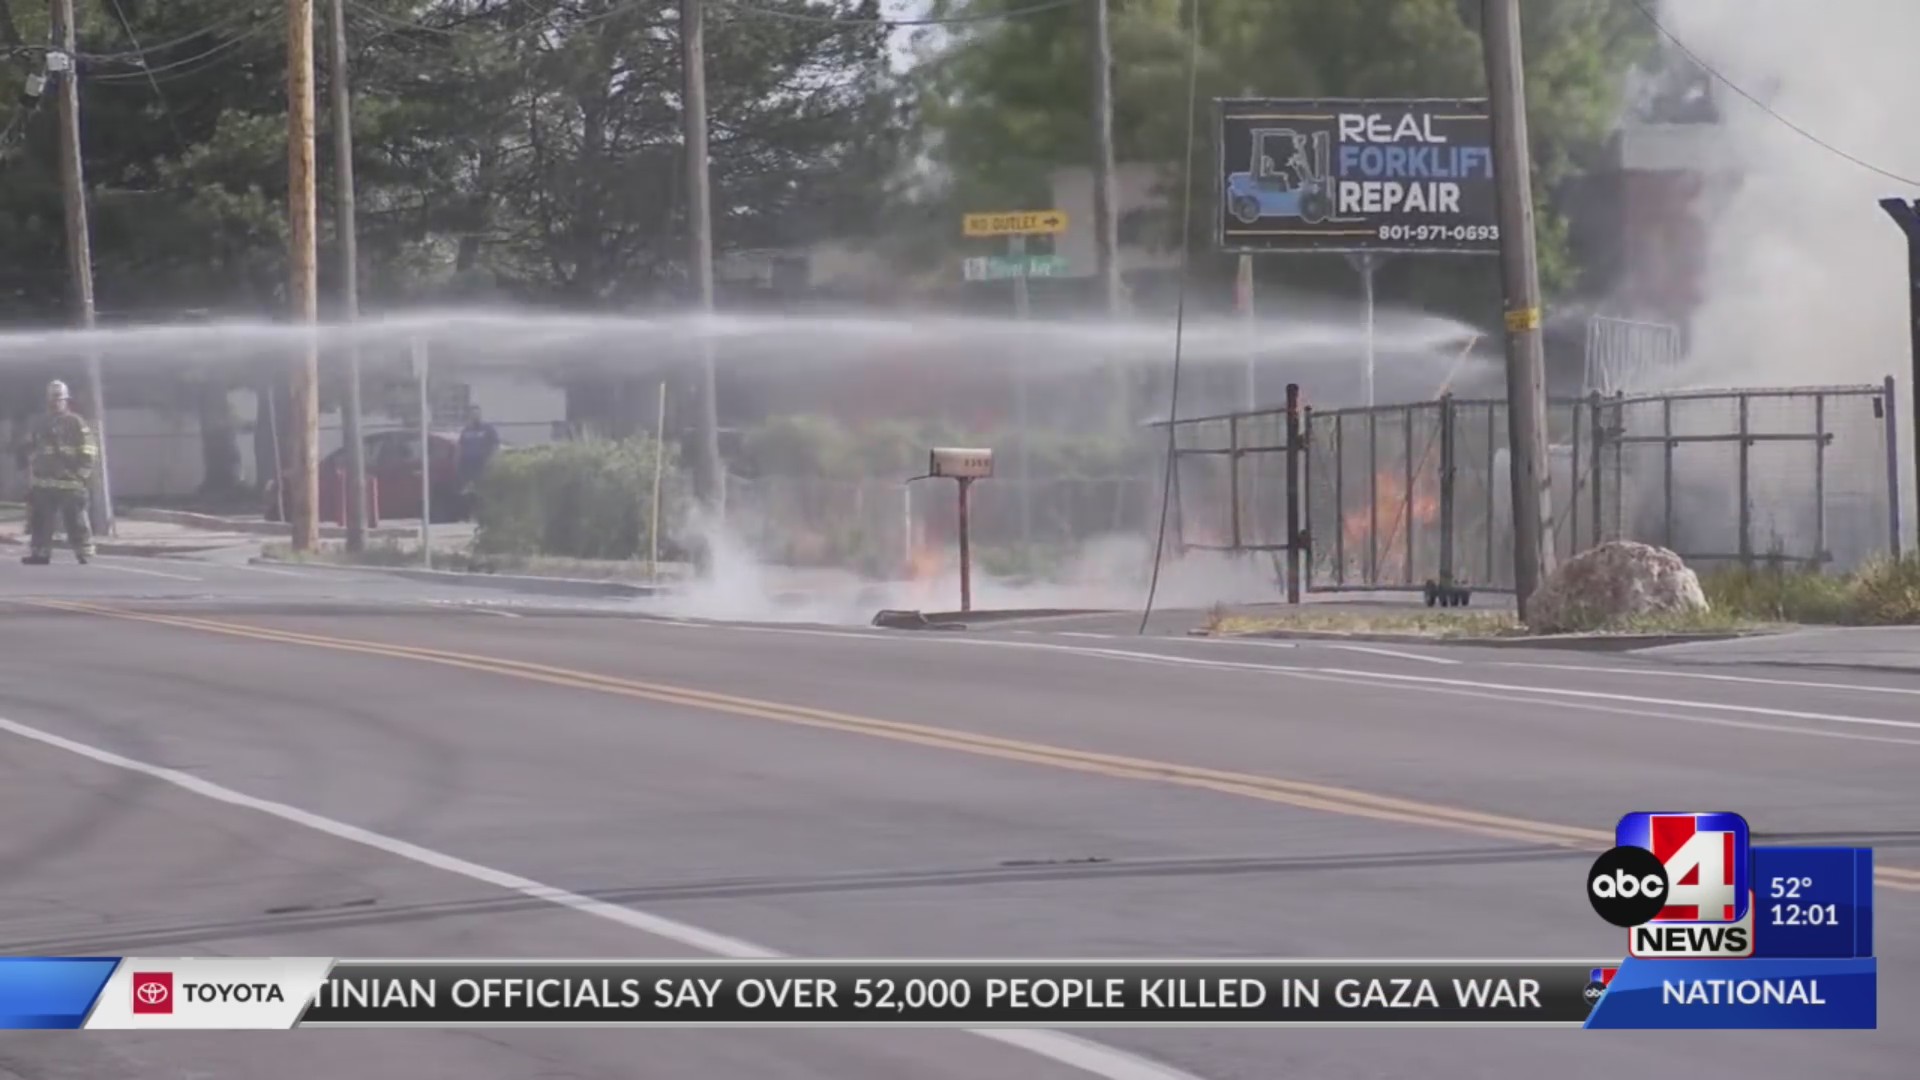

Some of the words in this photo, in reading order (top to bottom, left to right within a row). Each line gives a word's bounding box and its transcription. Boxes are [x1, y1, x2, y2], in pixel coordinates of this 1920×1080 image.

[1338, 113, 1448, 143] REAL
[1339, 146, 1493, 178] FORKLIFT
[1339, 181, 1460, 213] REPAIR
[970, 217, 988, 230] NO
[992, 215, 1038, 230] OUTLET
[1378, 225, 1500, 240] 801-971-0693
